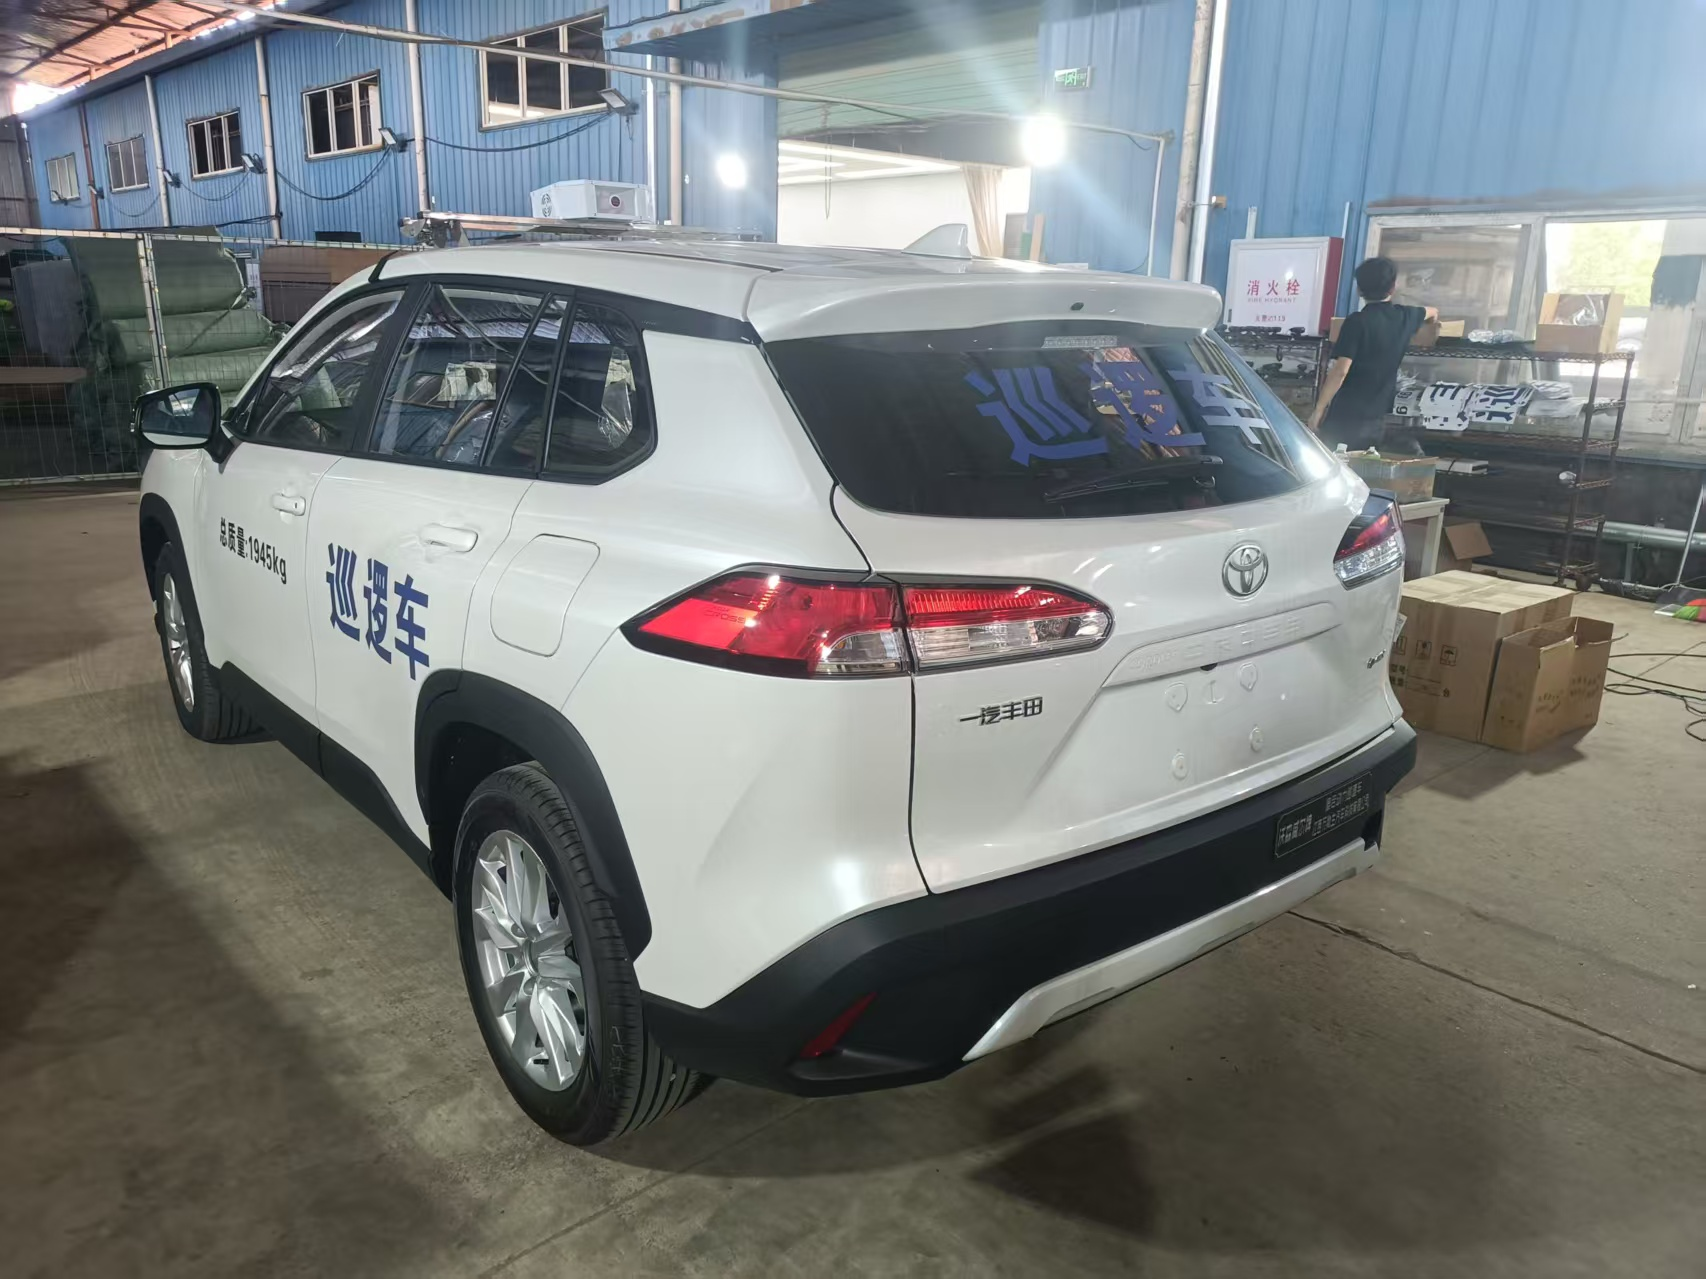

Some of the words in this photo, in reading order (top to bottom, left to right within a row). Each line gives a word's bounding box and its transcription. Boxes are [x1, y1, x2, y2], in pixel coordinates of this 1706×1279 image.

[1247, 279, 1300, 296] 消火栓
[964, 362, 1270, 468] 巡逻车
[219, 516, 287, 585] 总质量:1945kg
[326, 542, 430, 681] 巡逻车
[959, 696, 1043, 727] 一汽丰田
